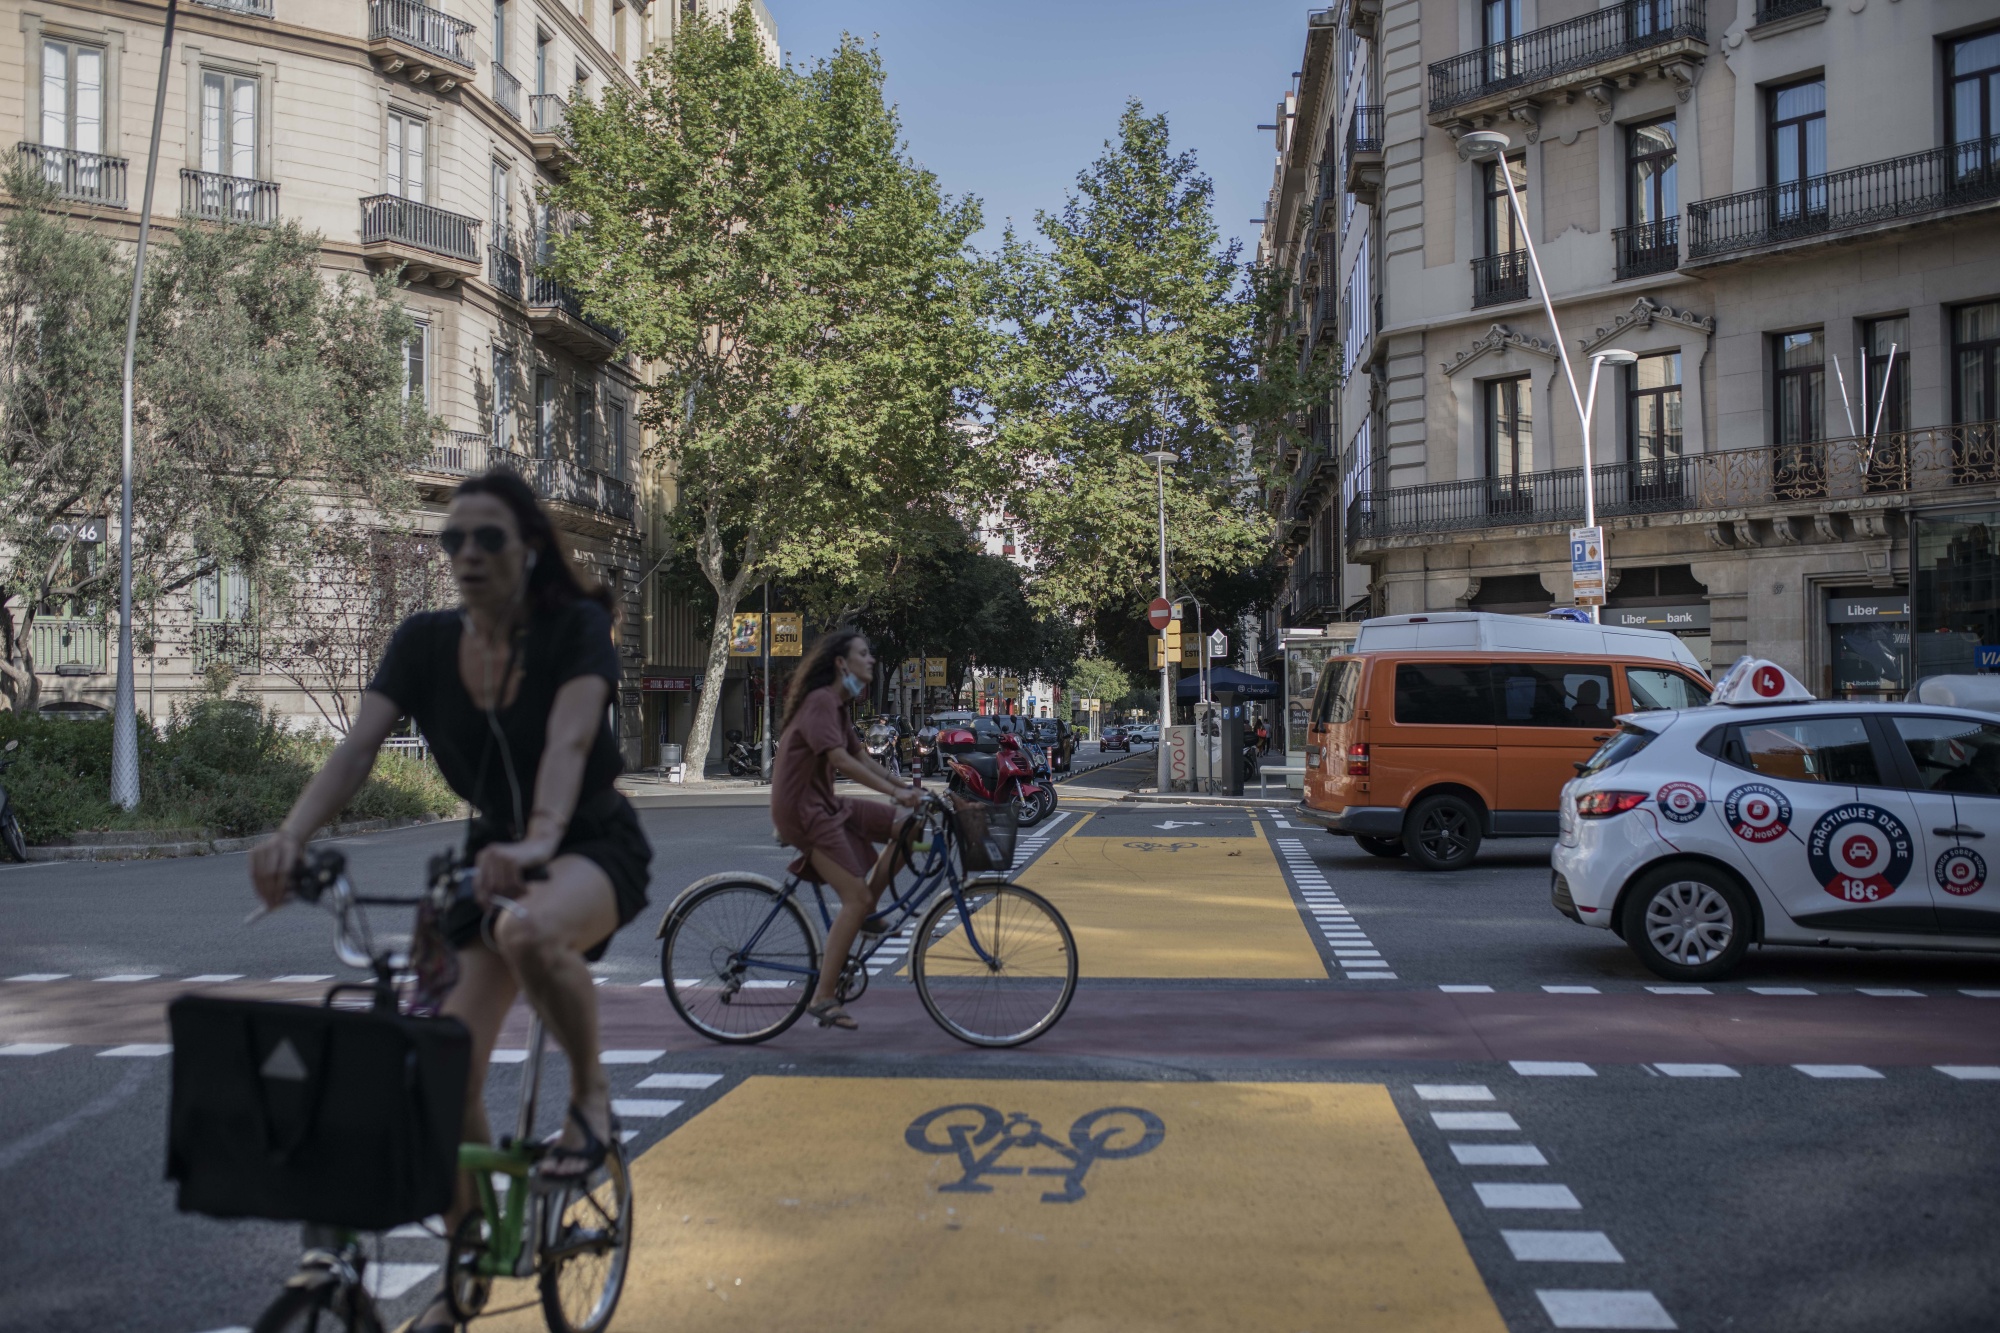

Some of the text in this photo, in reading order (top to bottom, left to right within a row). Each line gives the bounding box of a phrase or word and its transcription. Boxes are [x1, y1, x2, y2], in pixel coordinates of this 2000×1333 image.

[1574, 543, 1582, 560] P
[1847, 605, 1878, 616] Liber
[1621, 612, 1693, 624] Liber bank
[775, 634, 798, 642] ESTIU
[1763, 674, 1775, 689] 4
[1739, 824, 1783, 839] 18 HORES
[1878, 814, 1903, 838] DES
[1896, 841, 1908, 859] DE
[1949, 849, 1974, 858] SOBRE
[1841, 879, 1879, 900] 18€
[1946, 883, 1961, 893] BUS
